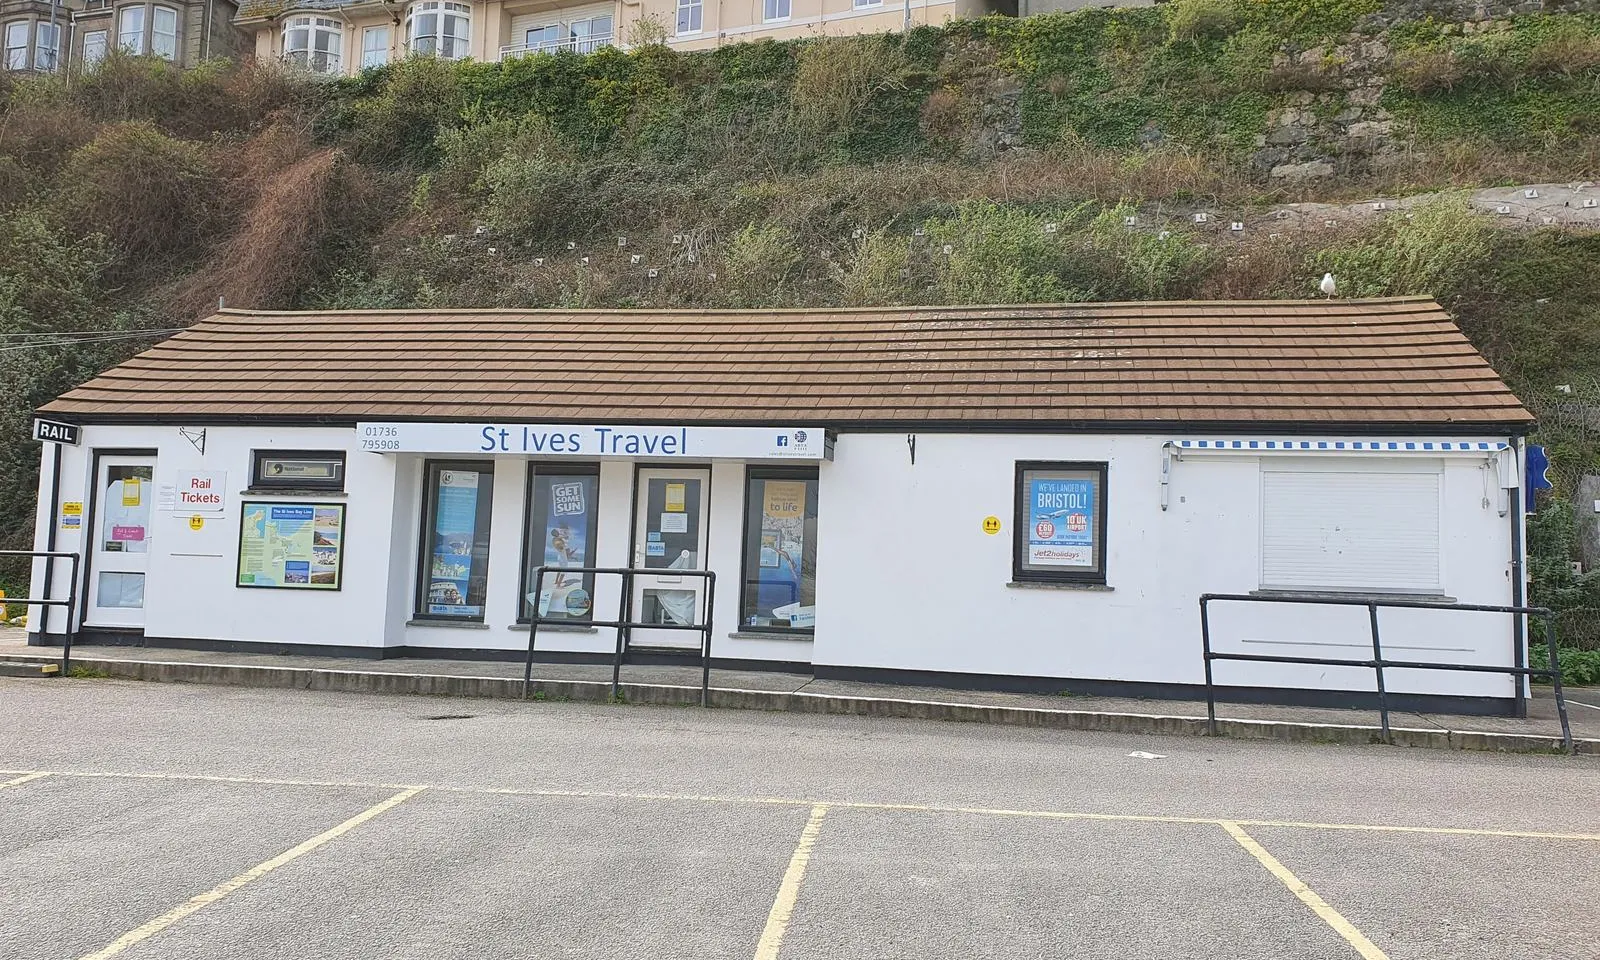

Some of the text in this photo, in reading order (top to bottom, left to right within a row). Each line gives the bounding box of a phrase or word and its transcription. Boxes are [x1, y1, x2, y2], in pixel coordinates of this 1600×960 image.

[40, 423, 73, 441] RAIL
[365, 426, 398, 437] 01736
[361, 439, 400, 450] 795908
[481, 426, 688, 455] St Ives Travel
[191, 478, 211, 489] Rail
[1056, 483, 1079, 493] LANDED
[1080, 484, 1087, 493] IN
[555, 486, 580, 497] GET
[180, 491, 220, 504] Tickets
[556, 494, 581, 504] SOME
[1038, 493, 1087, 509] BRISTOL!
[557, 501, 581, 513] SUN
[770, 502, 798, 512] to life
[1034, 549, 1080, 559] Jet2holidays
